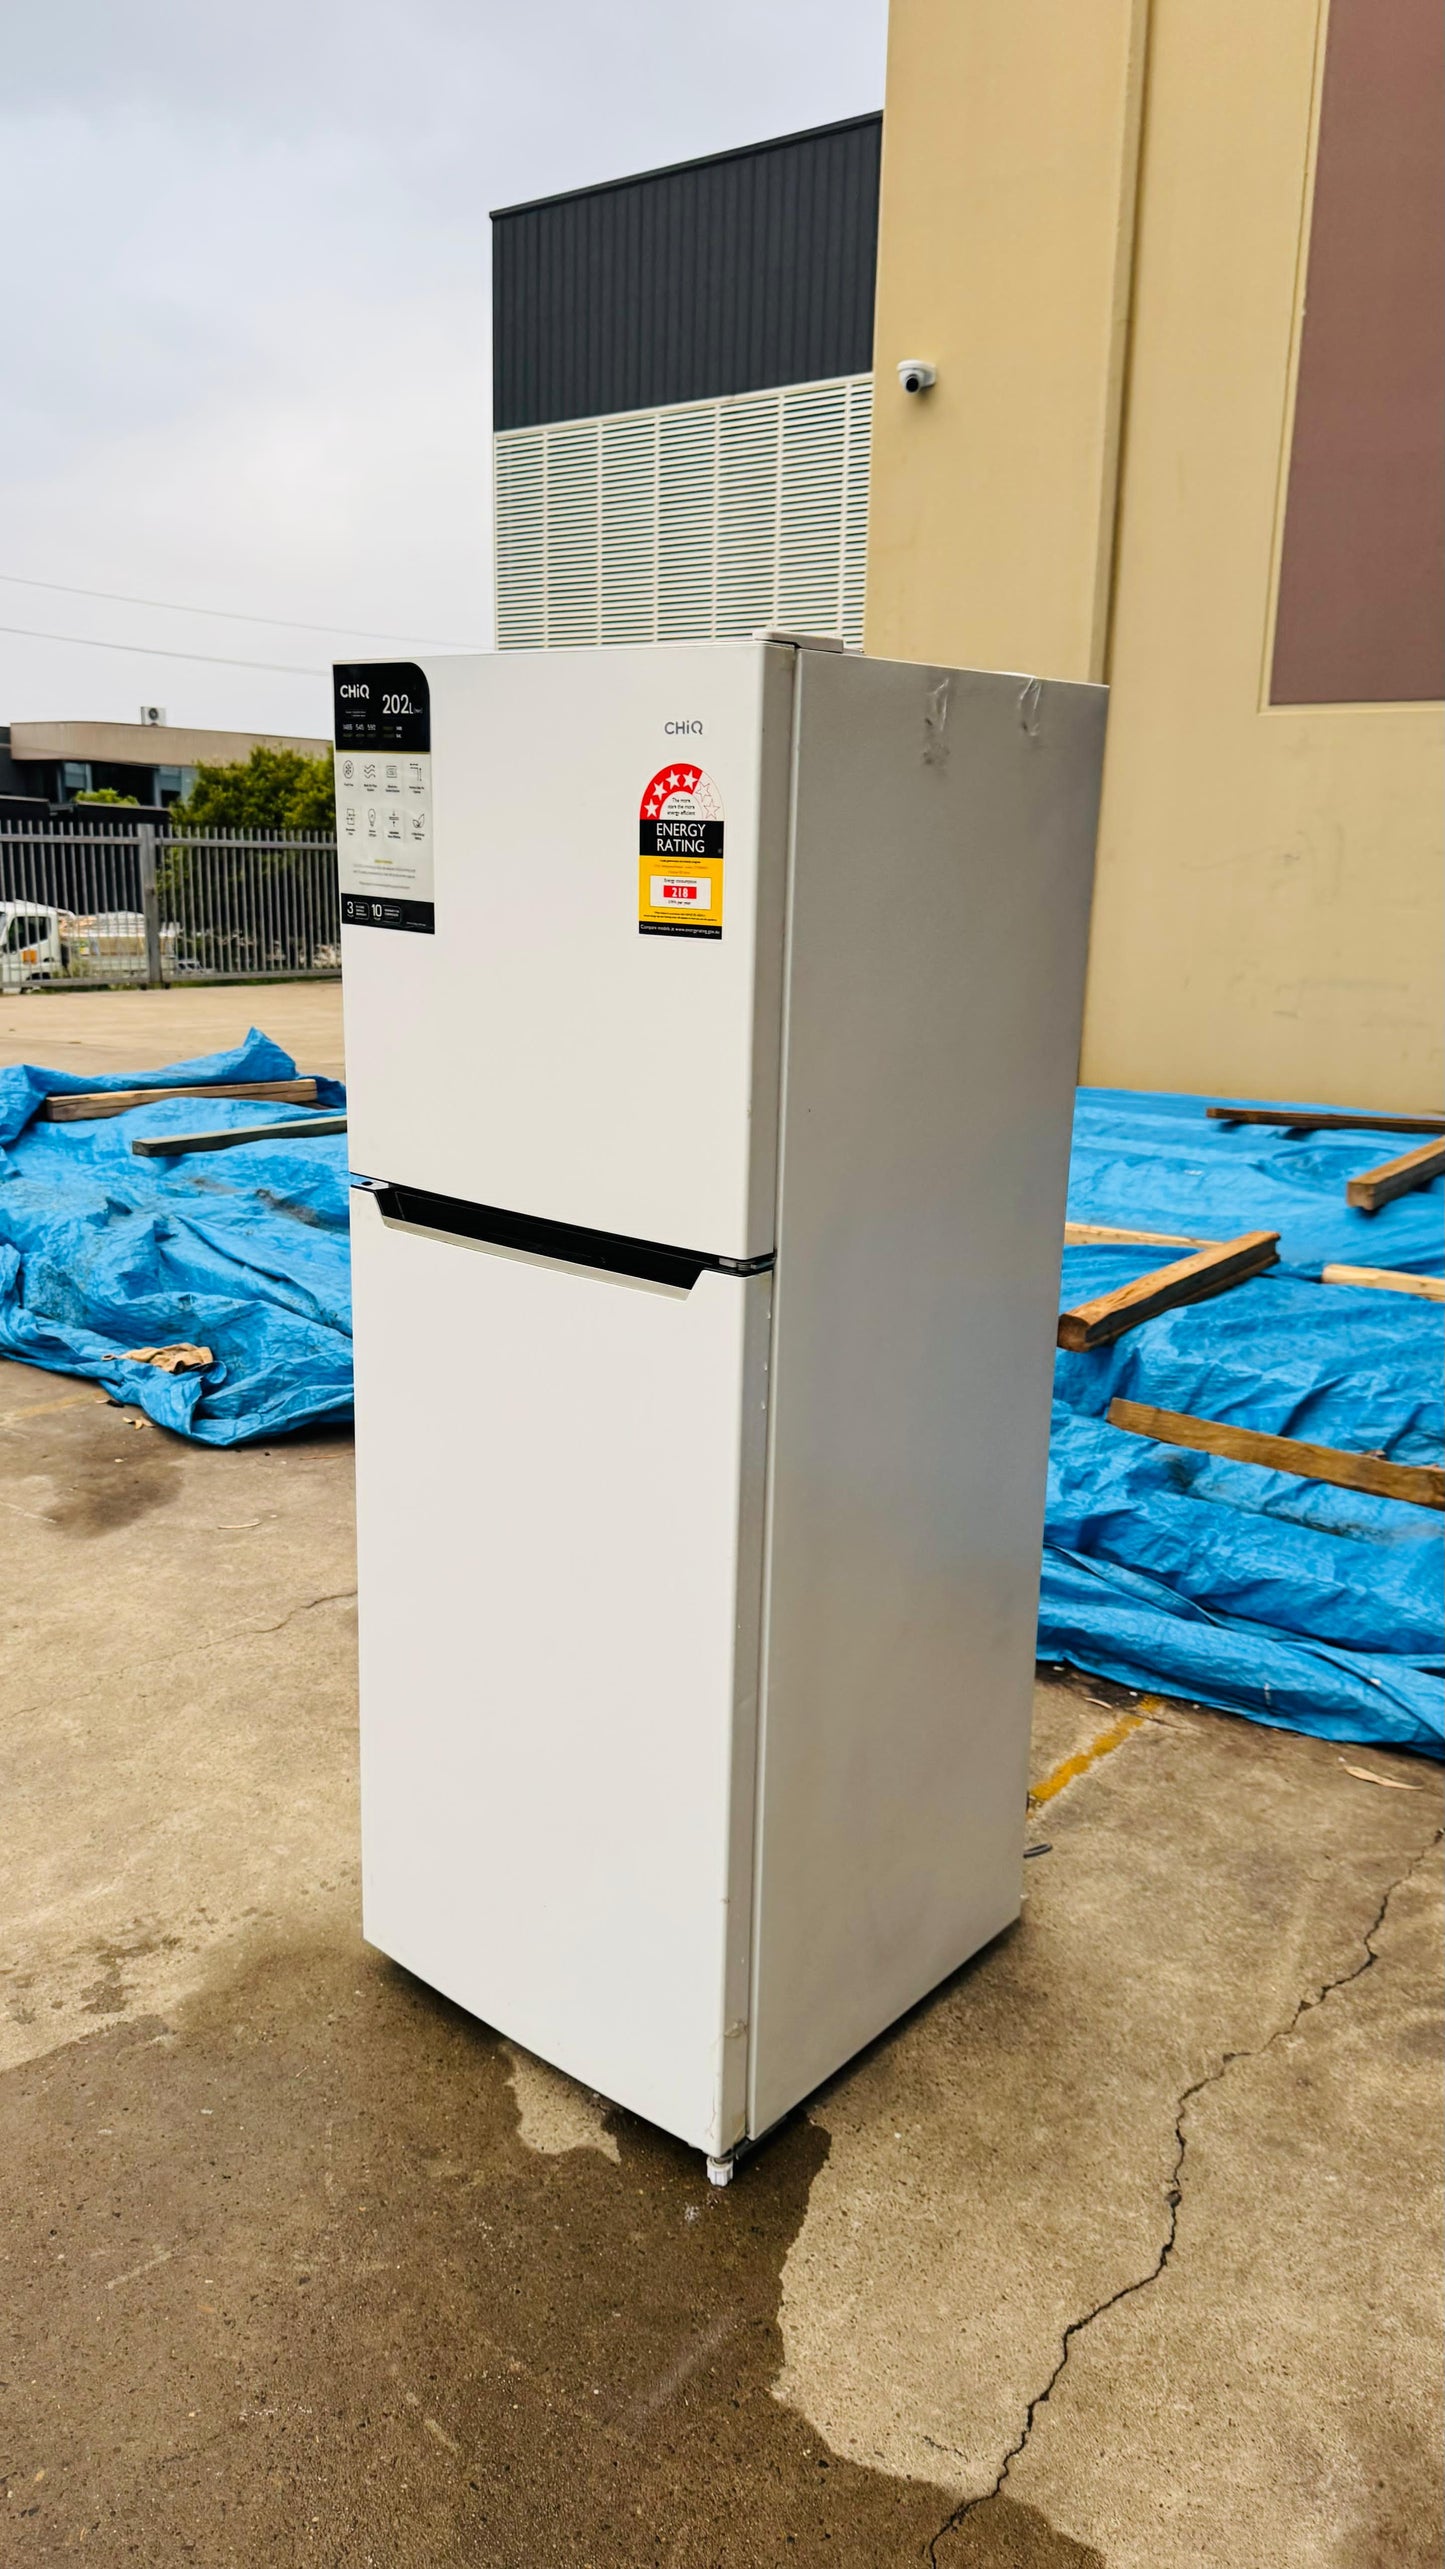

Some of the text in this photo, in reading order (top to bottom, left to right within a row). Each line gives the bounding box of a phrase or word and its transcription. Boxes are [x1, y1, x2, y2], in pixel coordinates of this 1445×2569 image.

[340, 684, 370, 699] CHiQ
[664, 720, 703, 735] CHiQ
[656, 823, 706, 837] ENERGY
[656, 838, 705, 853] RATING
[672, 887, 688, 898] 218
[346, 901, 354, 914] 3
[371, 904, 382, 917] 10
